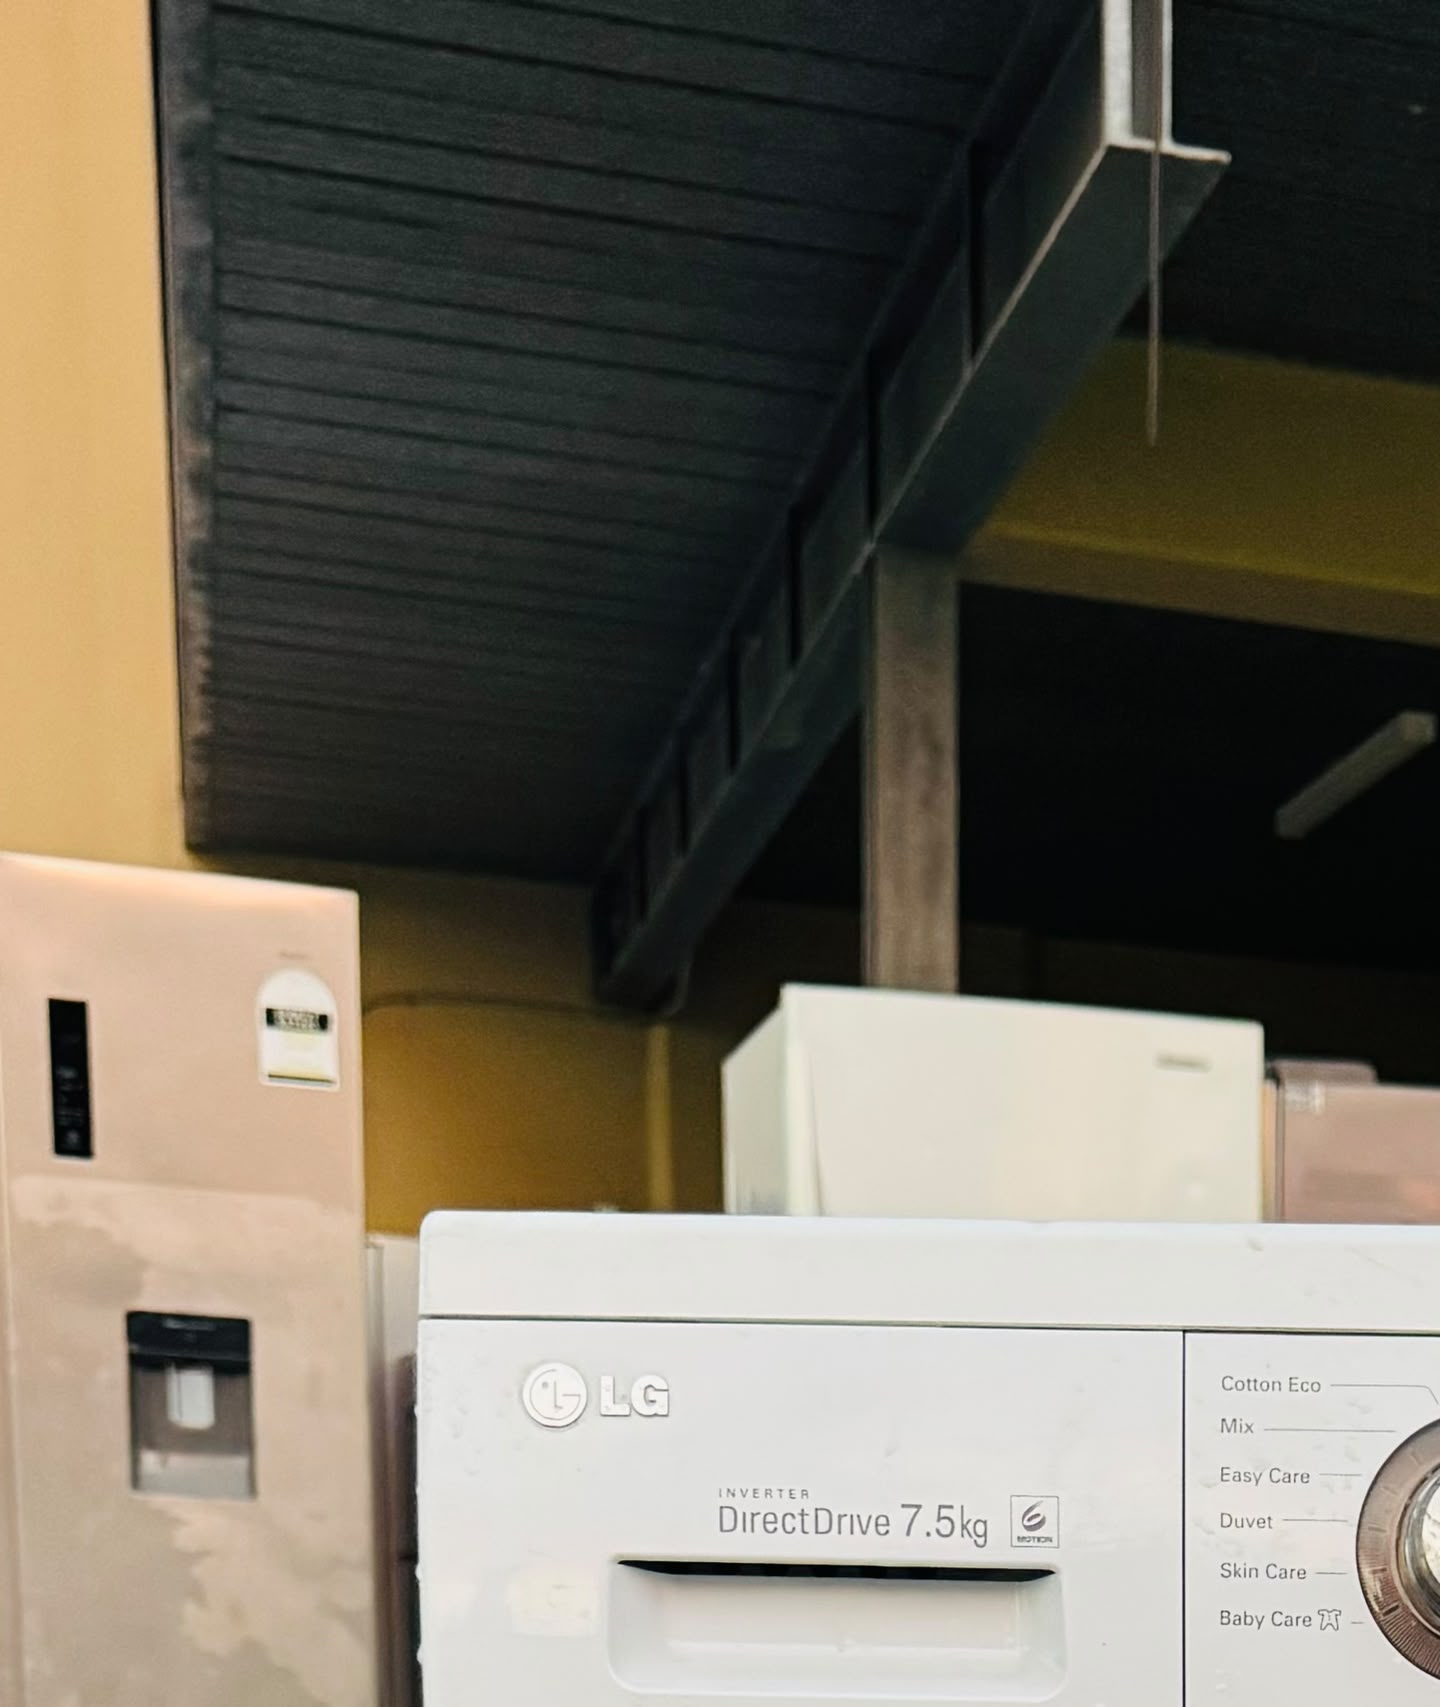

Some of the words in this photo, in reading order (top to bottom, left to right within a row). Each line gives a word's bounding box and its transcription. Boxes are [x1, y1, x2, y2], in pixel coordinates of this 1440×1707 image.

[1221, 1376, 1282, 1393] Cotton
[1287, 1376, 1321, 1393] Eco
[600, 1375, 669, 1417] LG
[1220, 1419, 1254, 1435] Mix
[1220, 1468, 1265, 1486] Easy
[1269, 1468, 1311, 1484] Care
[718, 1488, 810, 1500] INVERTER
[1220, 1513, 1273, 1529] Duvet
[1220, 1563, 1260, 1580] Skin
[1265, 1563, 1307, 1580] Care
[1219, 1610, 1265, 1630] Baby
[1269, 1611, 1312, 1627] Care
